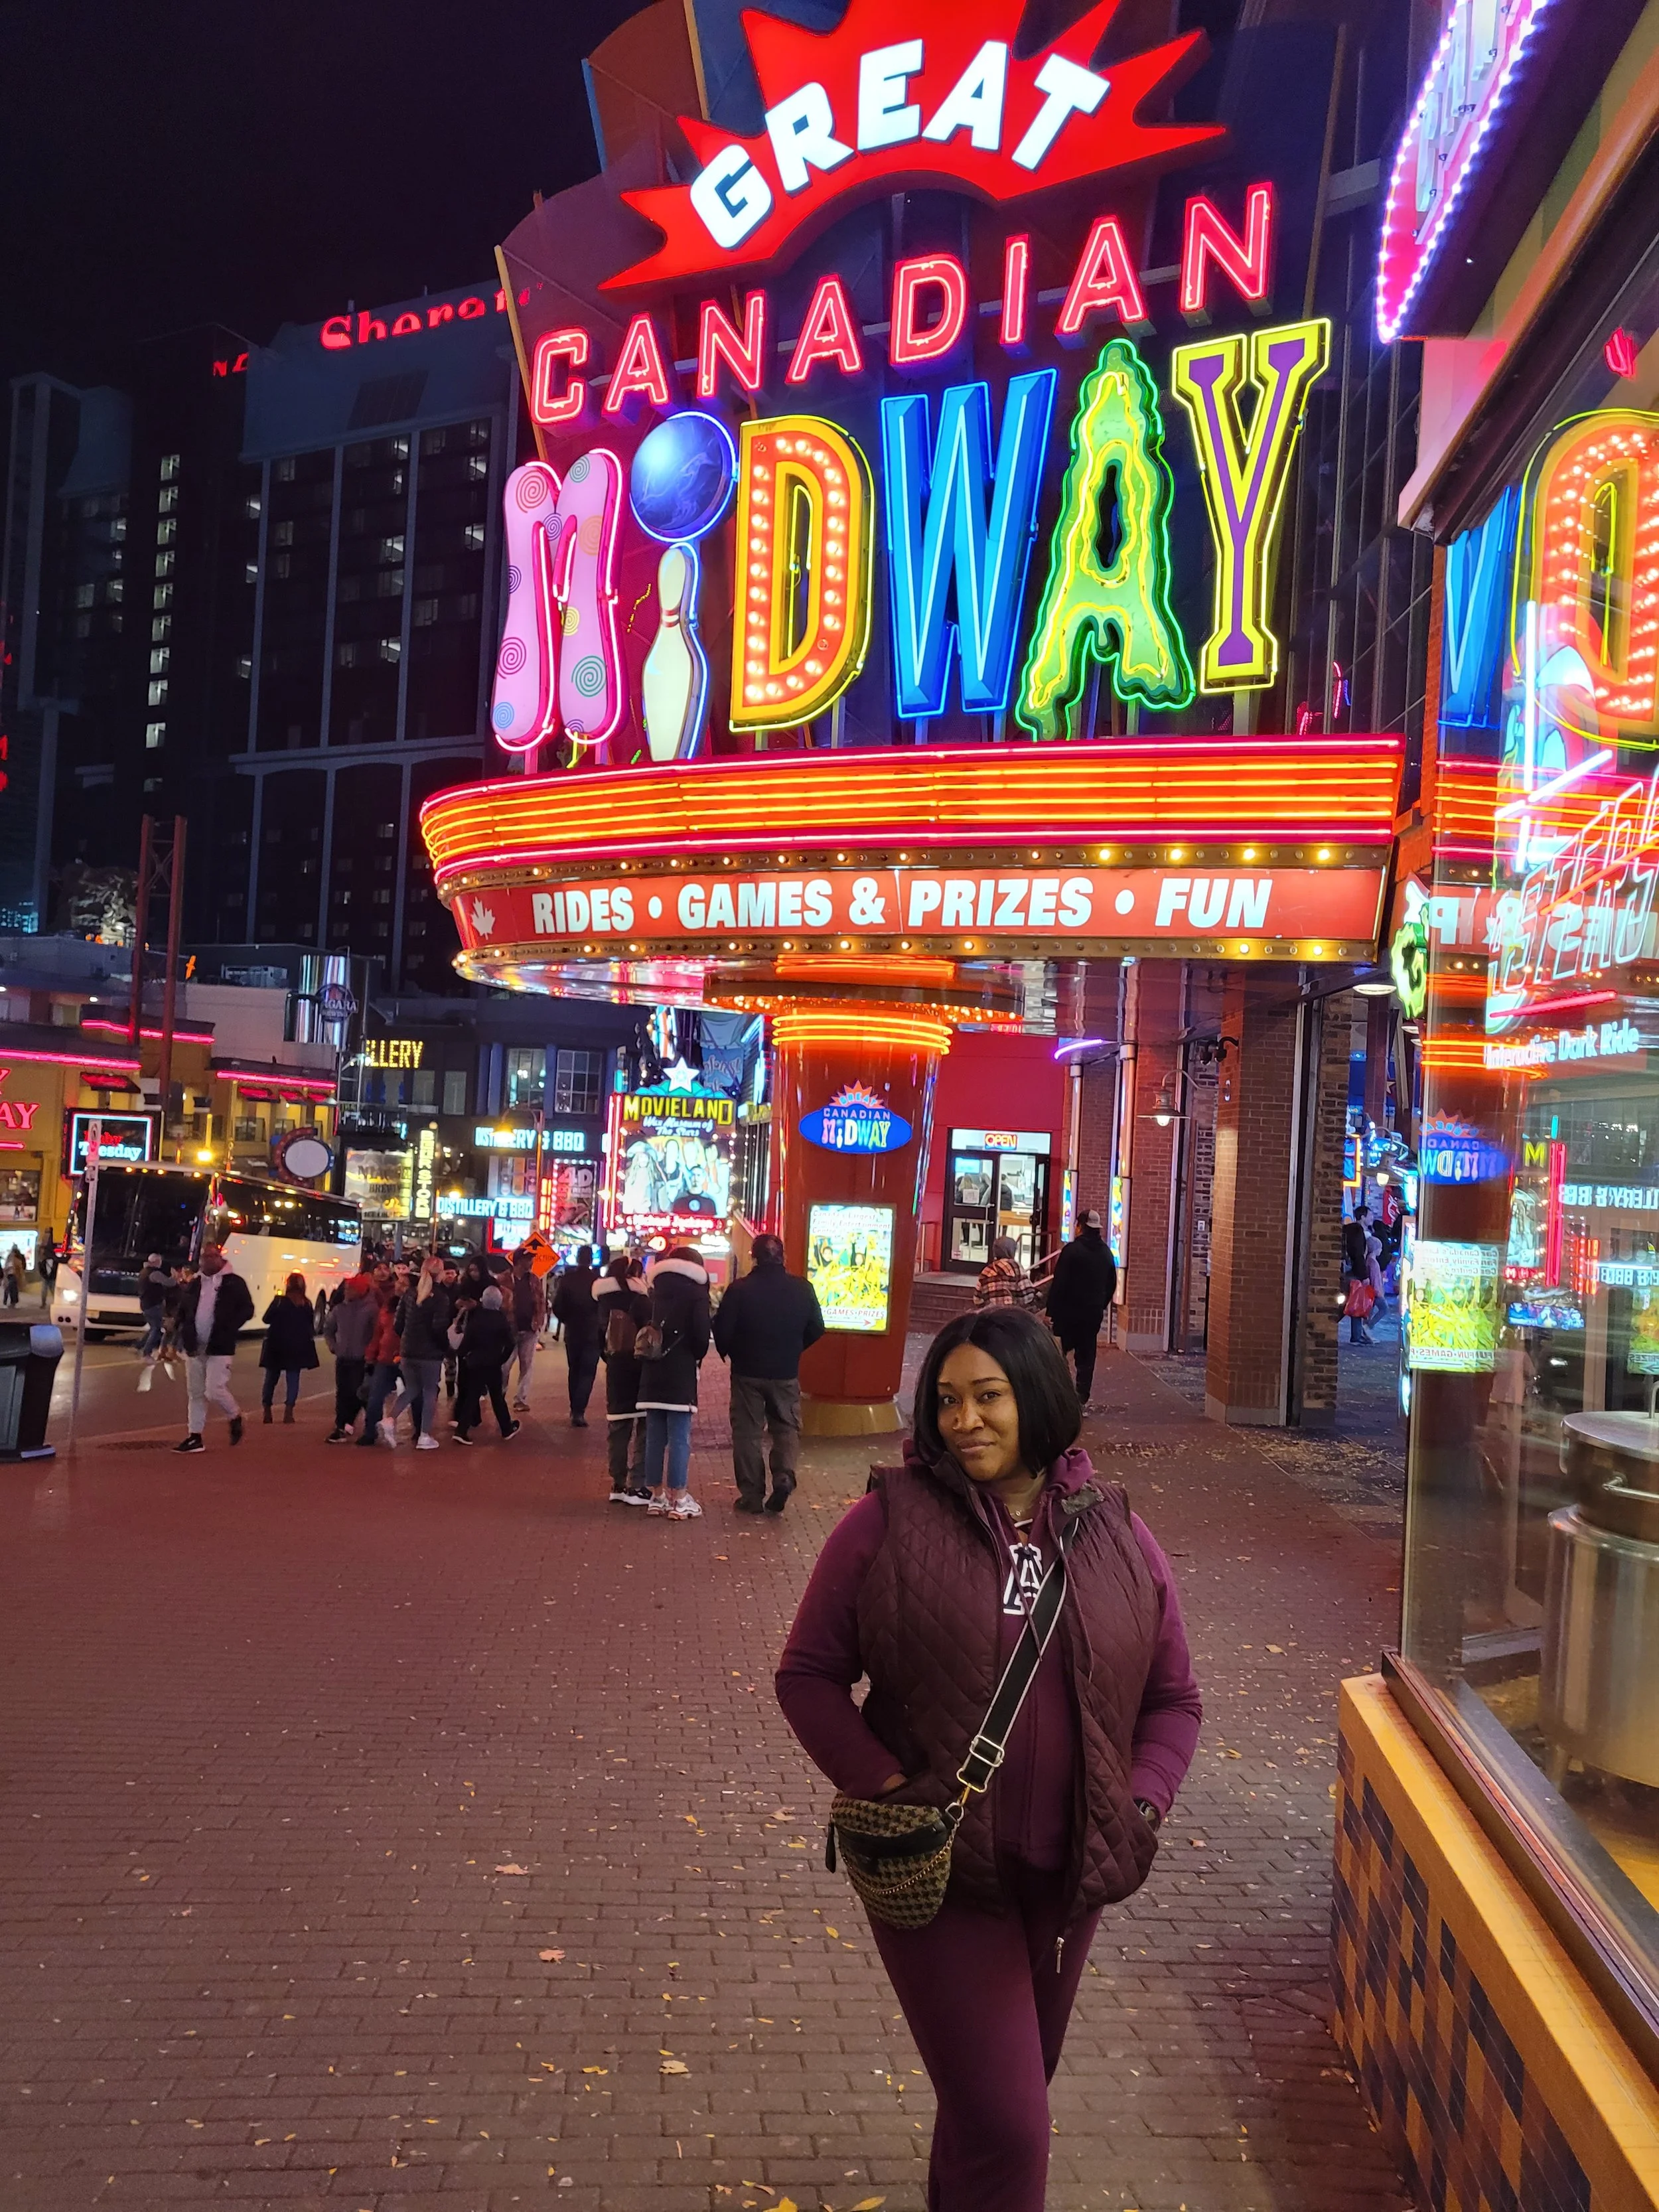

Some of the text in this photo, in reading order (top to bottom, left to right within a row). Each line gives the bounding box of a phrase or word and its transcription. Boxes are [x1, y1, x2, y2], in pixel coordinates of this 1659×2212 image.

[690, 38, 1111, 250] GREAT
[532, 183, 1275, 425] CANADIAN
[532, 877, 1273, 934] RIDES GAMES & PRIZES FUN
[1559, 1025, 1598, 1061] Dark
[1600, 1018, 1640, 1055] Ride
[622, 1095, 734, 1125] MOVIELAND
[823, 1108, 891, 1120] CANADIAN
[78, 1140, 143, 1161] Tesday
[553, 1131, 585, 1151] BBQ
[985, 1134, 1017, 1147] OPEN
[558, 1167, 593, 1187] 4D
[436, 1196, 497, 1217] DISTILLERY
[510, 1201, 534, 1220] BBQ
[857, 1309, 885, 1318] PRIZES
